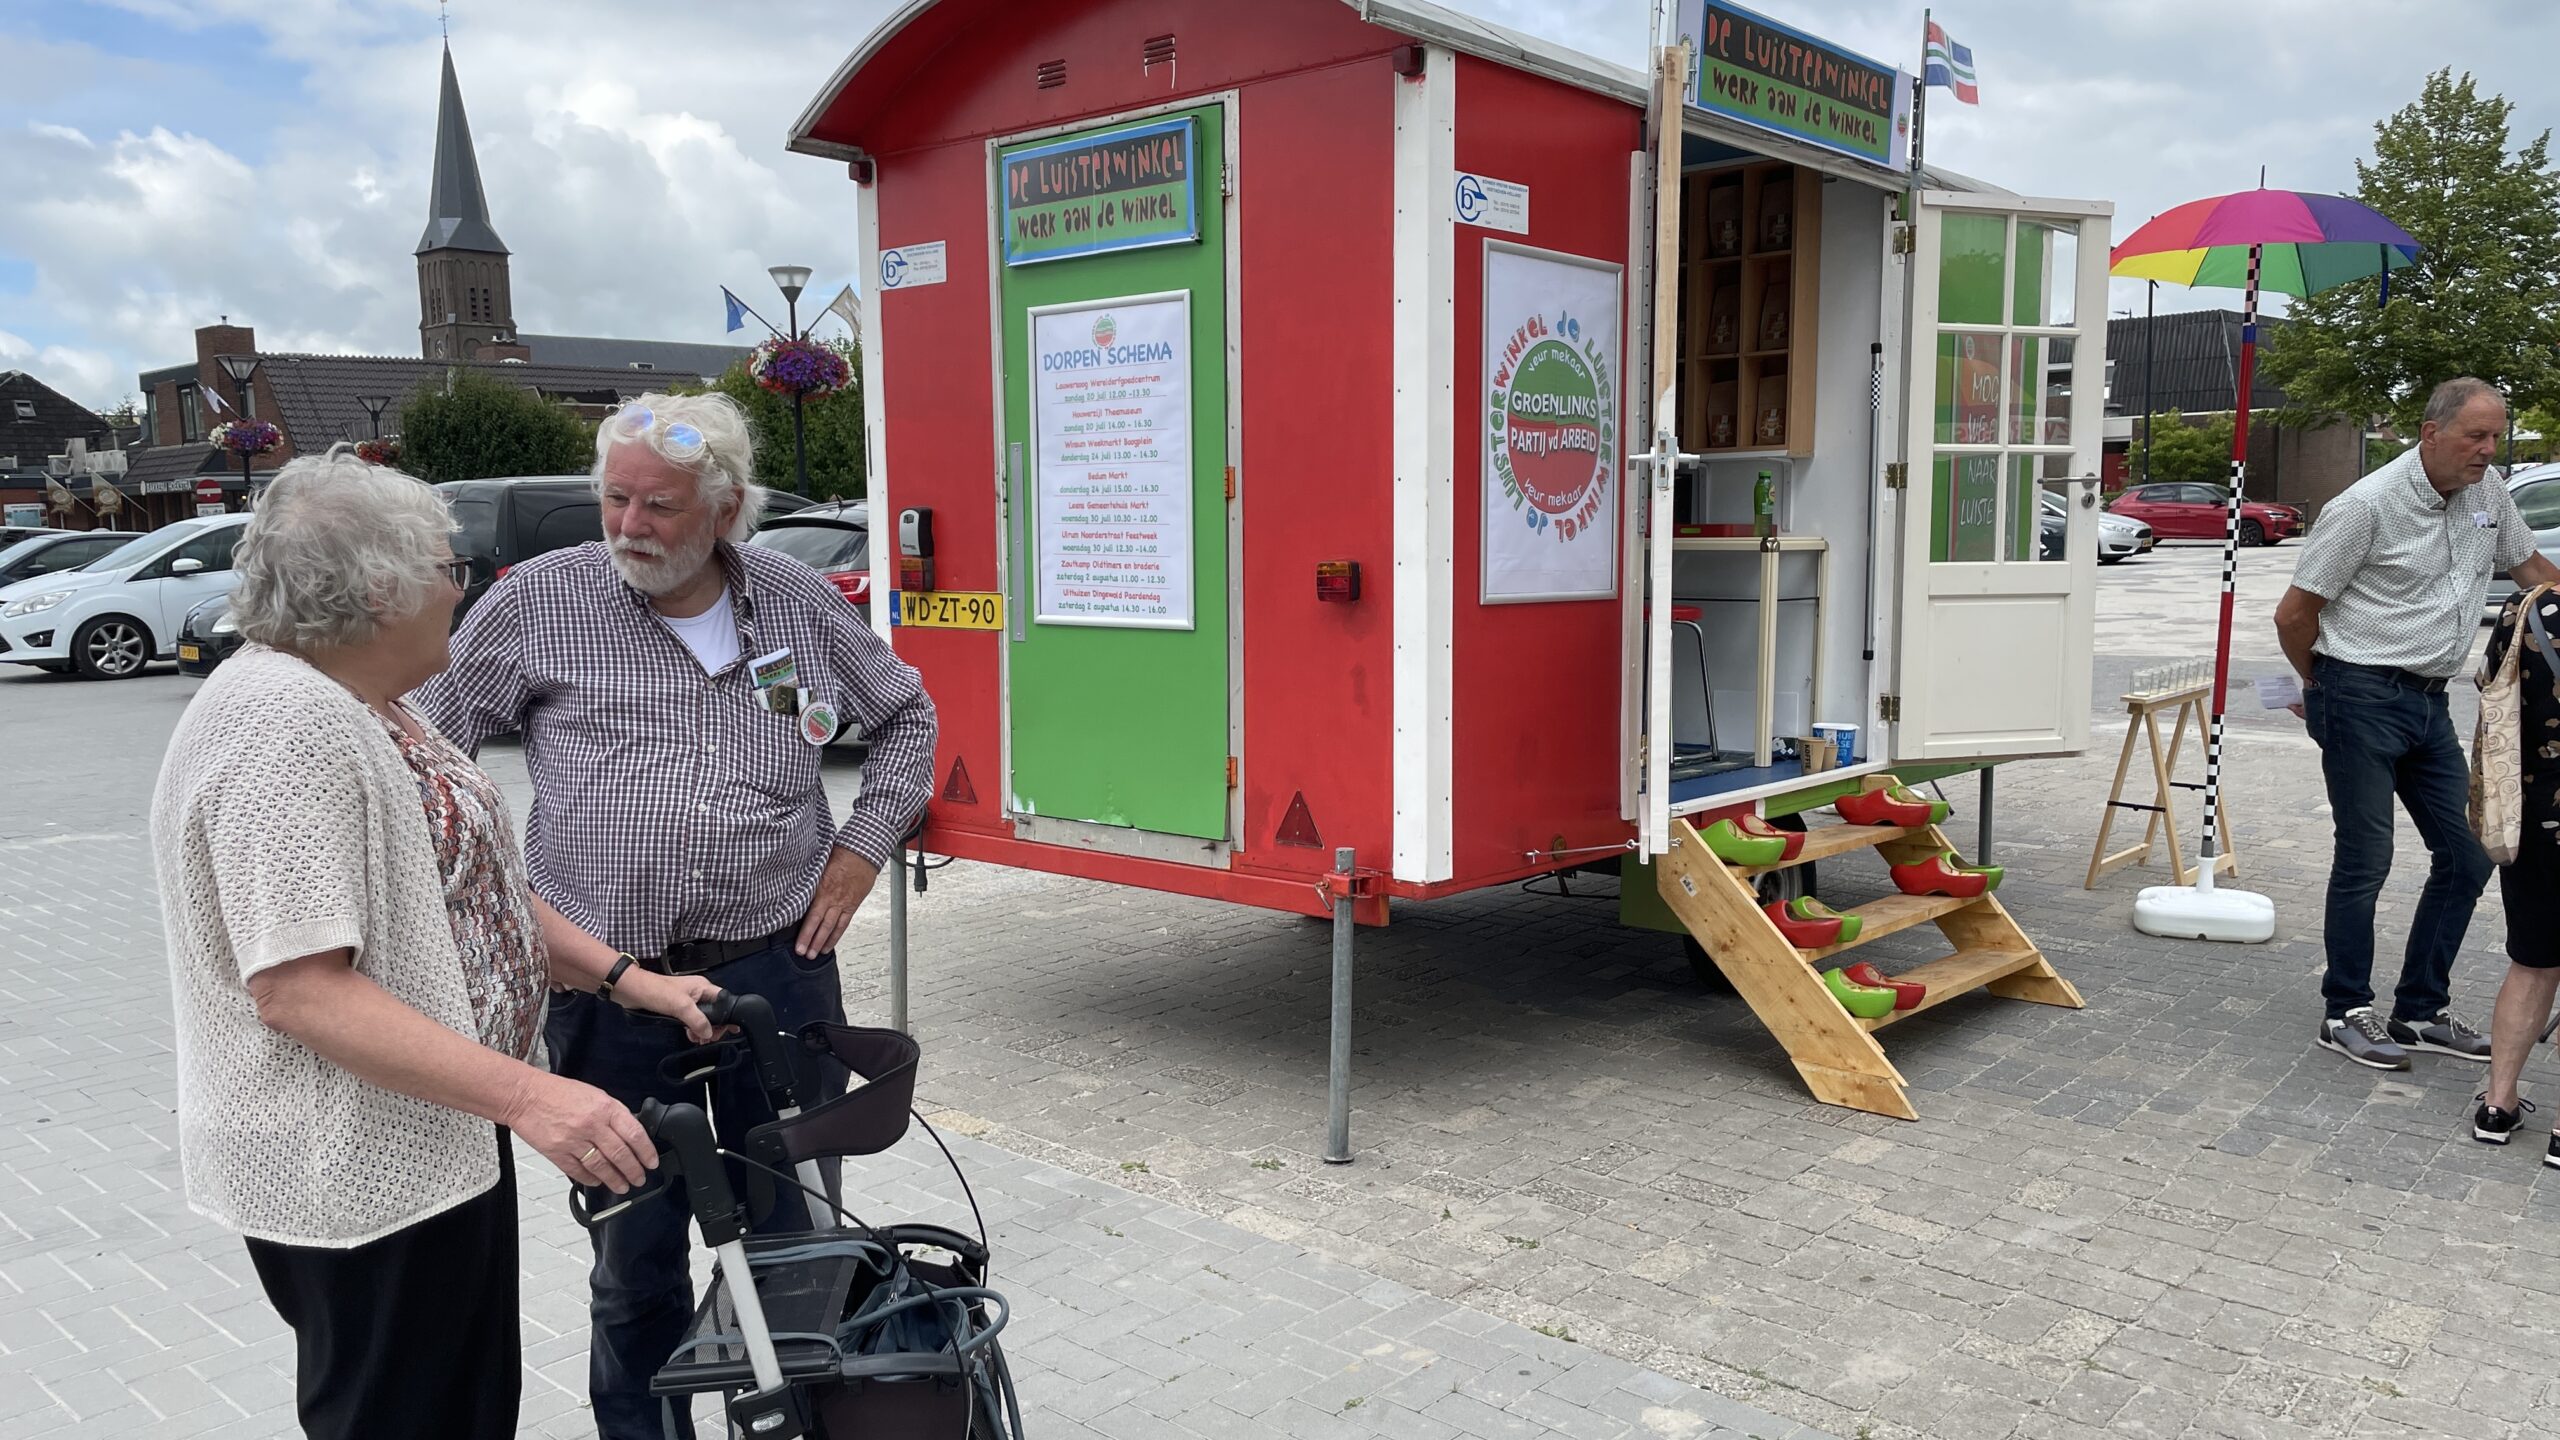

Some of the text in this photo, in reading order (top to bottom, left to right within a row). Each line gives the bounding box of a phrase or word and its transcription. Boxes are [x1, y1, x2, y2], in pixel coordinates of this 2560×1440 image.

[1043, 341, 1172, 371] DORPEN SCHEMA
[1528, 348, 1586, 379] veur mekaar
[1512, 390, 1597, 419] GROENLINKS
[1511, 427, 1597, 457] PARTIJ vd ARBEID
[1108, 471, 1128, 479] Markt
[1140, 484, 1159, 493] 16.30
[1524, 478, 1582, 506] veur mekaar
[1130, 501, 1149, 509] Markt
[1100, 514, 1111, 523] juli
[1113, 514, 1132, 522] 10.30
[1140, 515, 1158, 523] 12.00
[1093, 544, 1101, 552] 30
[1102, 544, 1113, 554] juli
[1116, 545, 1134, 553] 12.30
[1121, 575, 1139, 583] 11.00
[1147, 575, 1166, 584] 12.30
[905, 596, 995, 624] WD-ZT-90
[1122, 604, 1140, 613] 14.30
[1148, 605, 1167, 614] 16.00
[892, 611, 900, 620] NL
